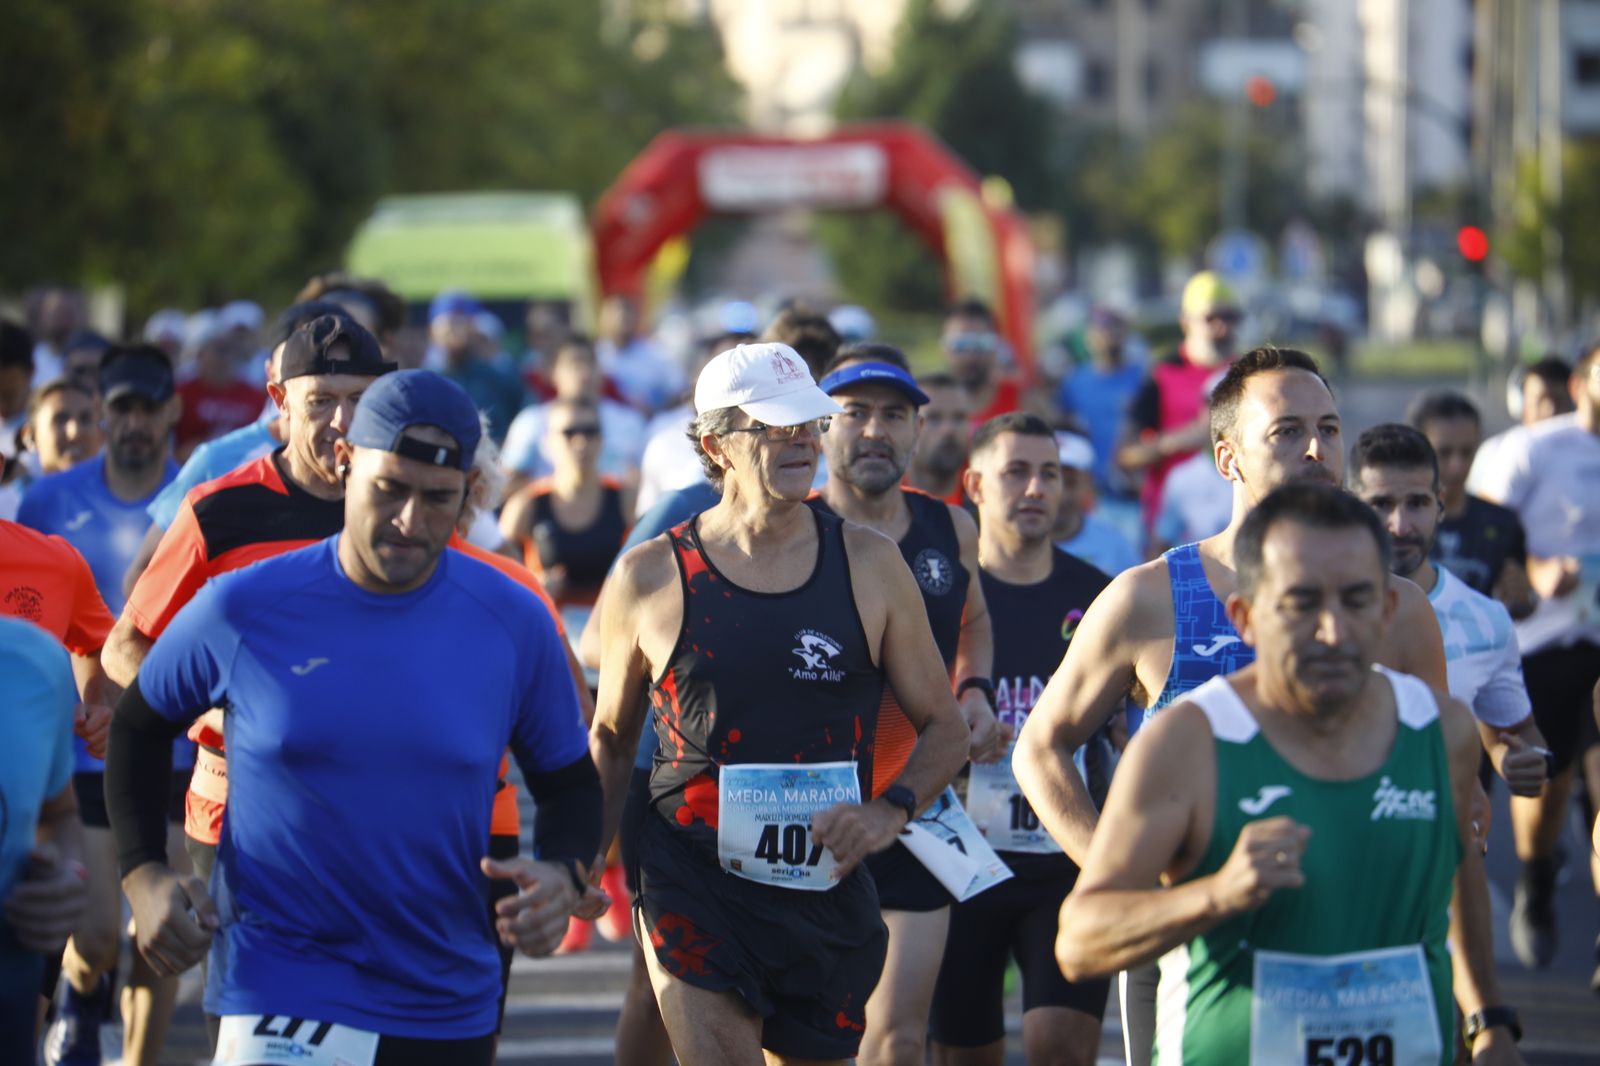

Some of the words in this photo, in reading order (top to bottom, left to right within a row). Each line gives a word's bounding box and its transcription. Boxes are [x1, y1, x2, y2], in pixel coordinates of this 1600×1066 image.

[727, 788, 778, 804] MEDIA
[784, 783, 856, 803] MARATÓN
[755, 824, 824, 866] 407
[1262, 986, 1330, 1009] MEDIA
[1306, 1033, 1395, 1066] 529
